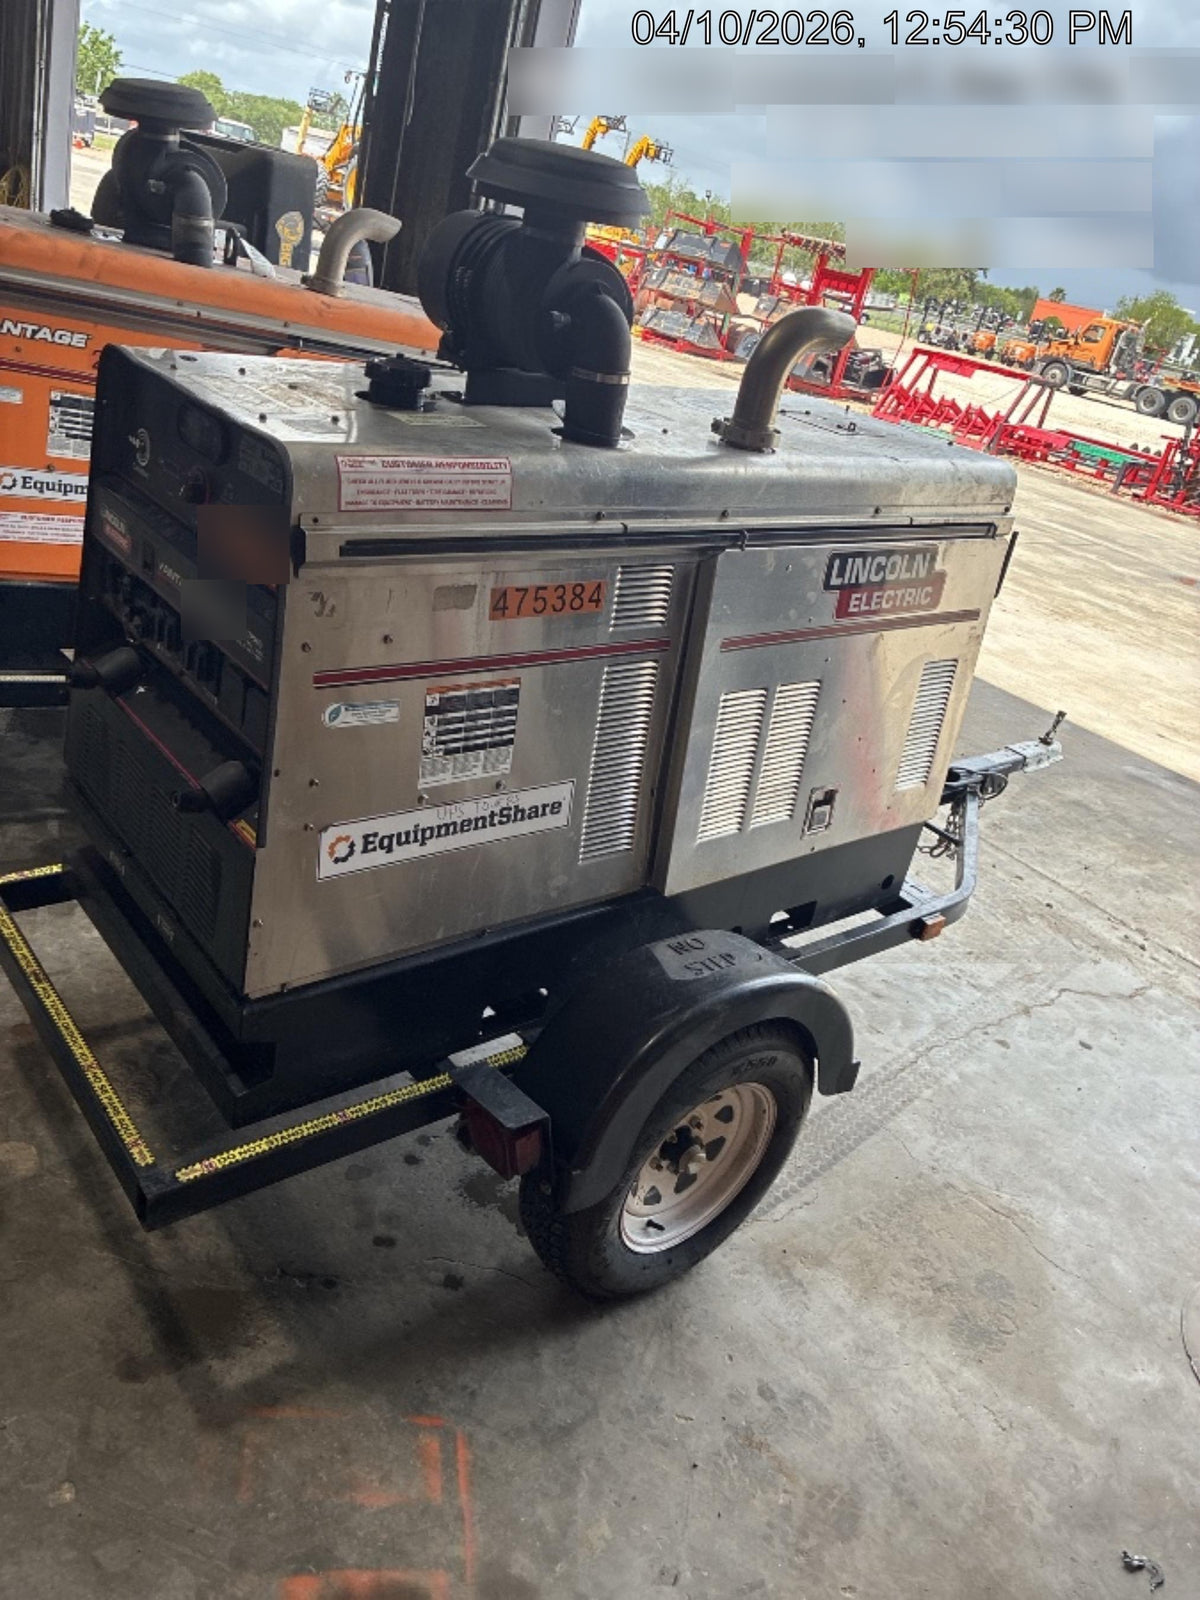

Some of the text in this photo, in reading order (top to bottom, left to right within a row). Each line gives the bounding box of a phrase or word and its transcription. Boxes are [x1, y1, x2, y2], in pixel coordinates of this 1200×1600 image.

[829, 553, 932, 586] LINCOLN
[491, 581, 605, 619] 475384
[848, 586, 933, 613] ELECTRIC
[360, 801, 564, 855] EquipmentShare
[667, 937, 706, 956] NO
